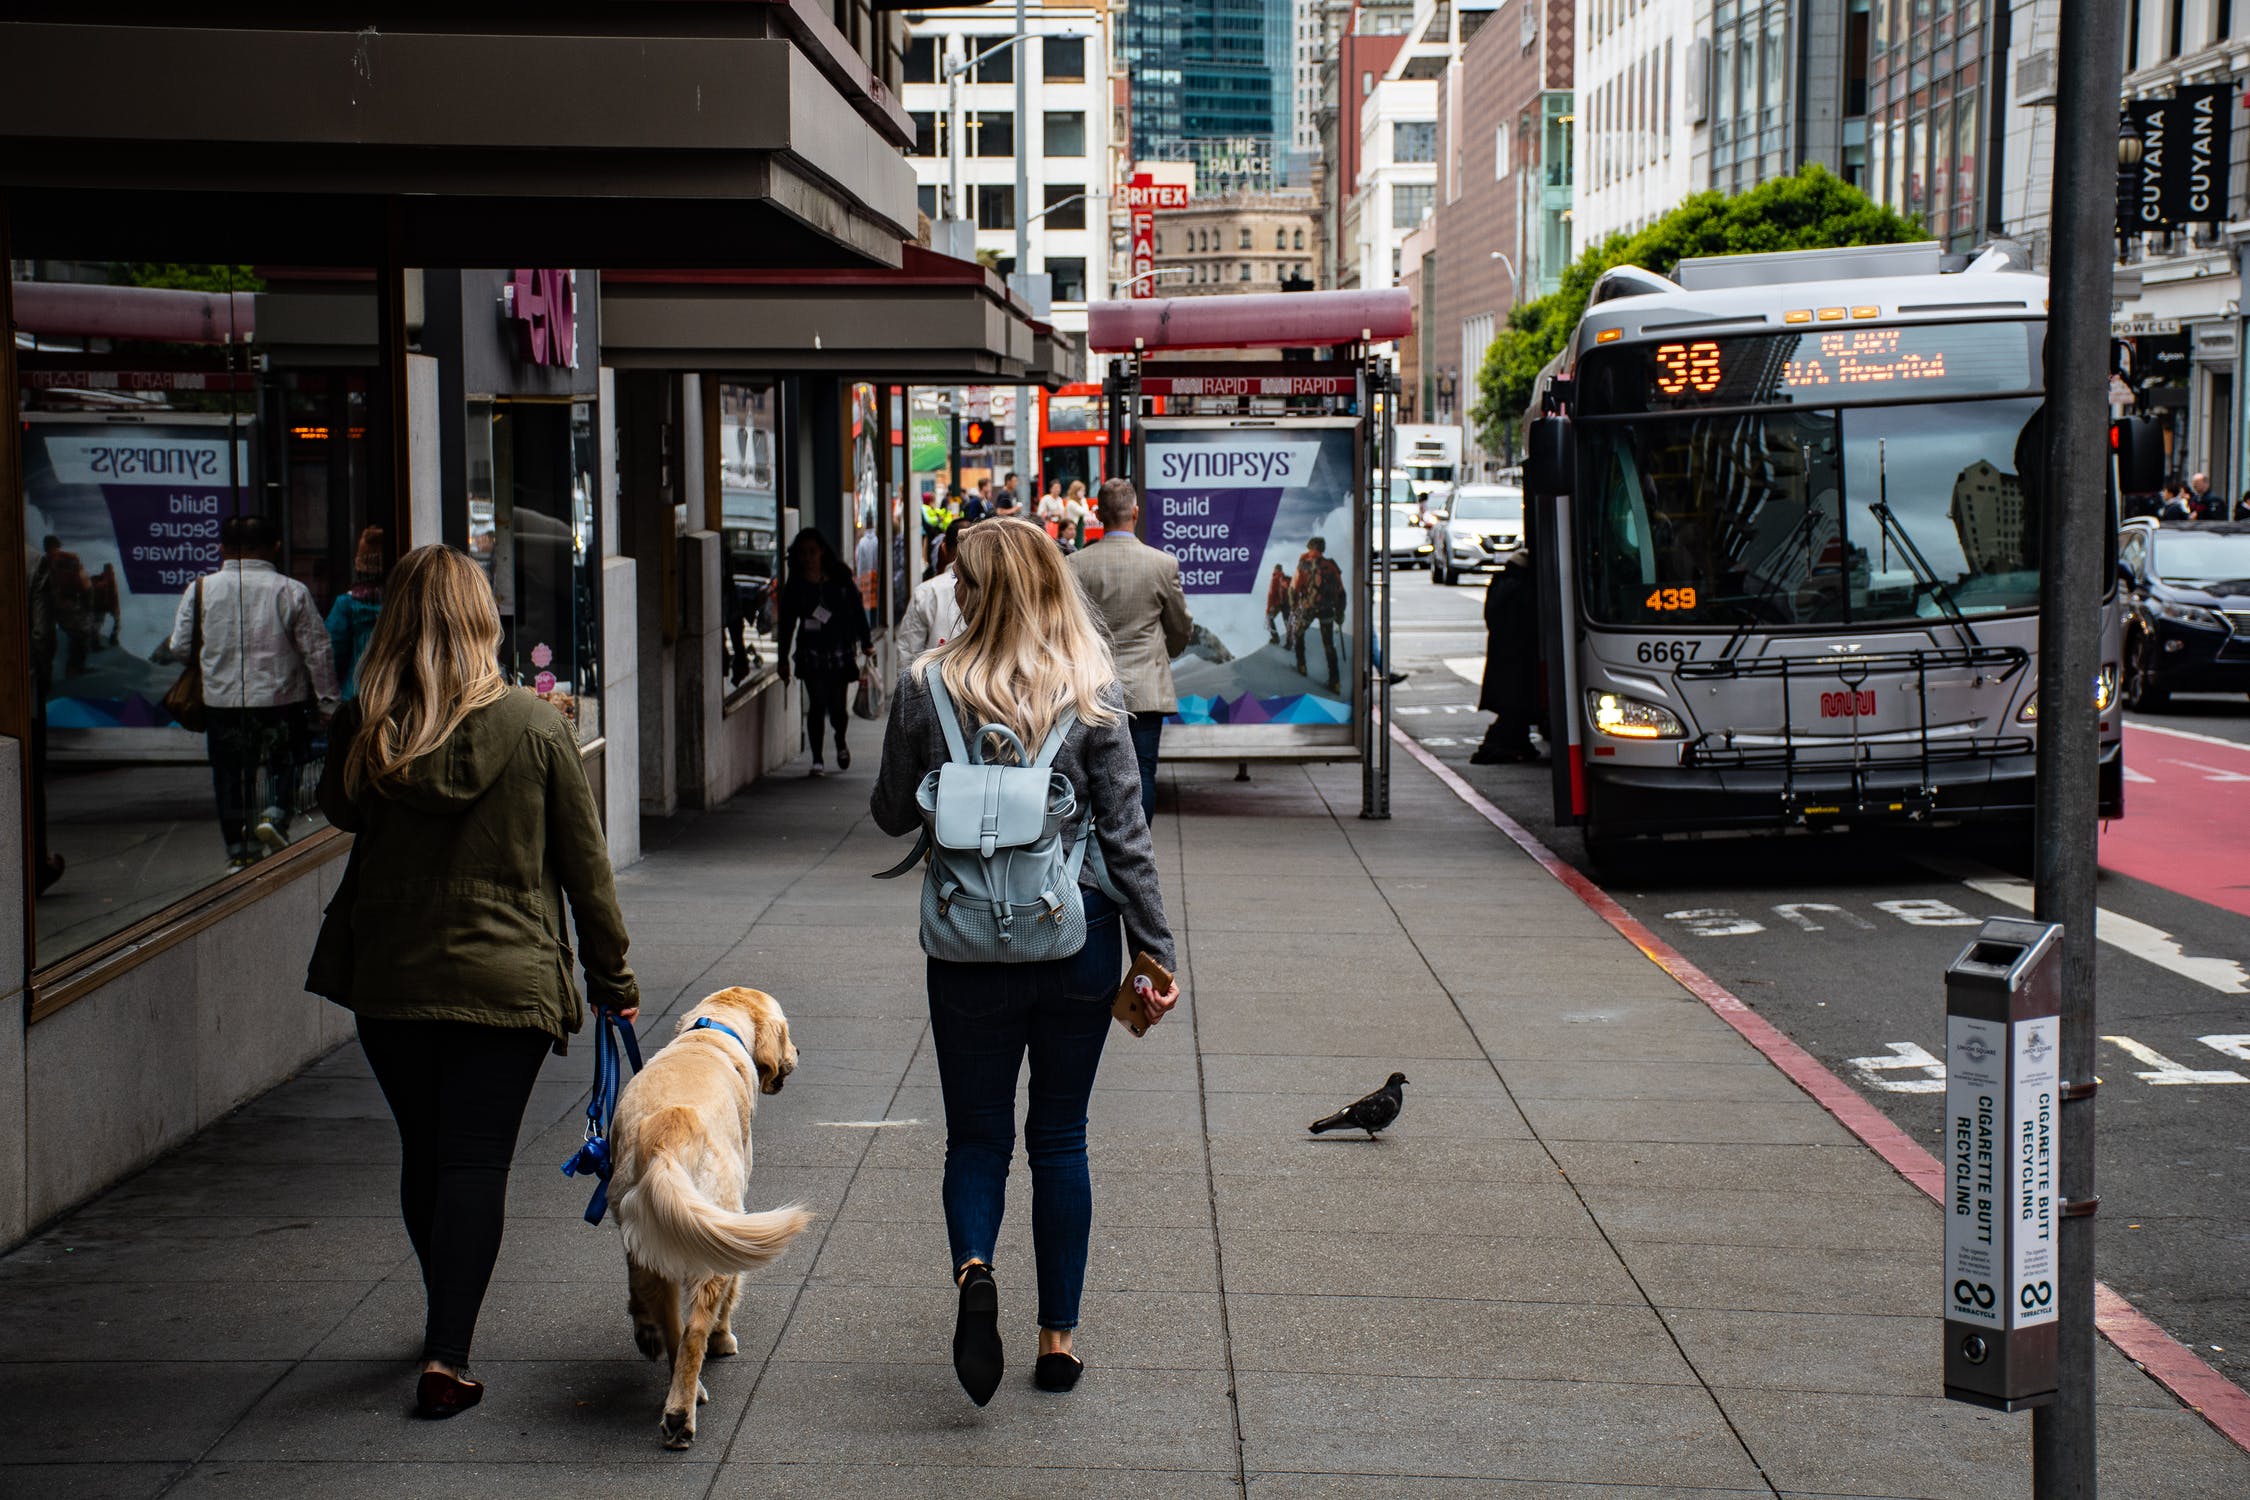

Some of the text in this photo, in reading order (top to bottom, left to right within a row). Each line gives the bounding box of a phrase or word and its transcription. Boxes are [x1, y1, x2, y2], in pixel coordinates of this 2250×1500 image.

[1227, 136, 1256, 154] THE
[2190, 95, 2214, 212] CUYANA
[1209, 157, 1271, 175] PALACE
[2141, 110, 2165, 222] CUYANA
[1116, 185, 1186, 207] BRITEX
[1135, 213, 1152, 297] FABR
[2113, 321, 2177, 333] POWELL
[1657, 343, 1721, 393] 38
[1205, 378, 1248, 394] RAPID
[1293, 378, 1337, 394] RAPID
[1162, 451, 1290, 483] SYNOPSYS
[1162, 497, 1210, 517] Build
[1162, 520, 1230, 540] Secure
[1179, 567, 1223, 586] aster
[1646, 587, 1697, 611] 439
[1637, 640, 1702, 663] 6667
[1957, 1043, 1996, 1056] UNION SQUARE
[1957, 1116, 1972, 1217] RECYCLING
[1978, 1095, 1993, 1246] CIGARETTE BUTT
[2022, 1120, 2034, 1220] RECYCLING
[2038, 1093, 2050, 1241] CIGARETTE BUTT
[1954, 1305, 1996, 1319] TERRACYCLE
[2020, 1306, 2053, 1319] TERRACYCLE
